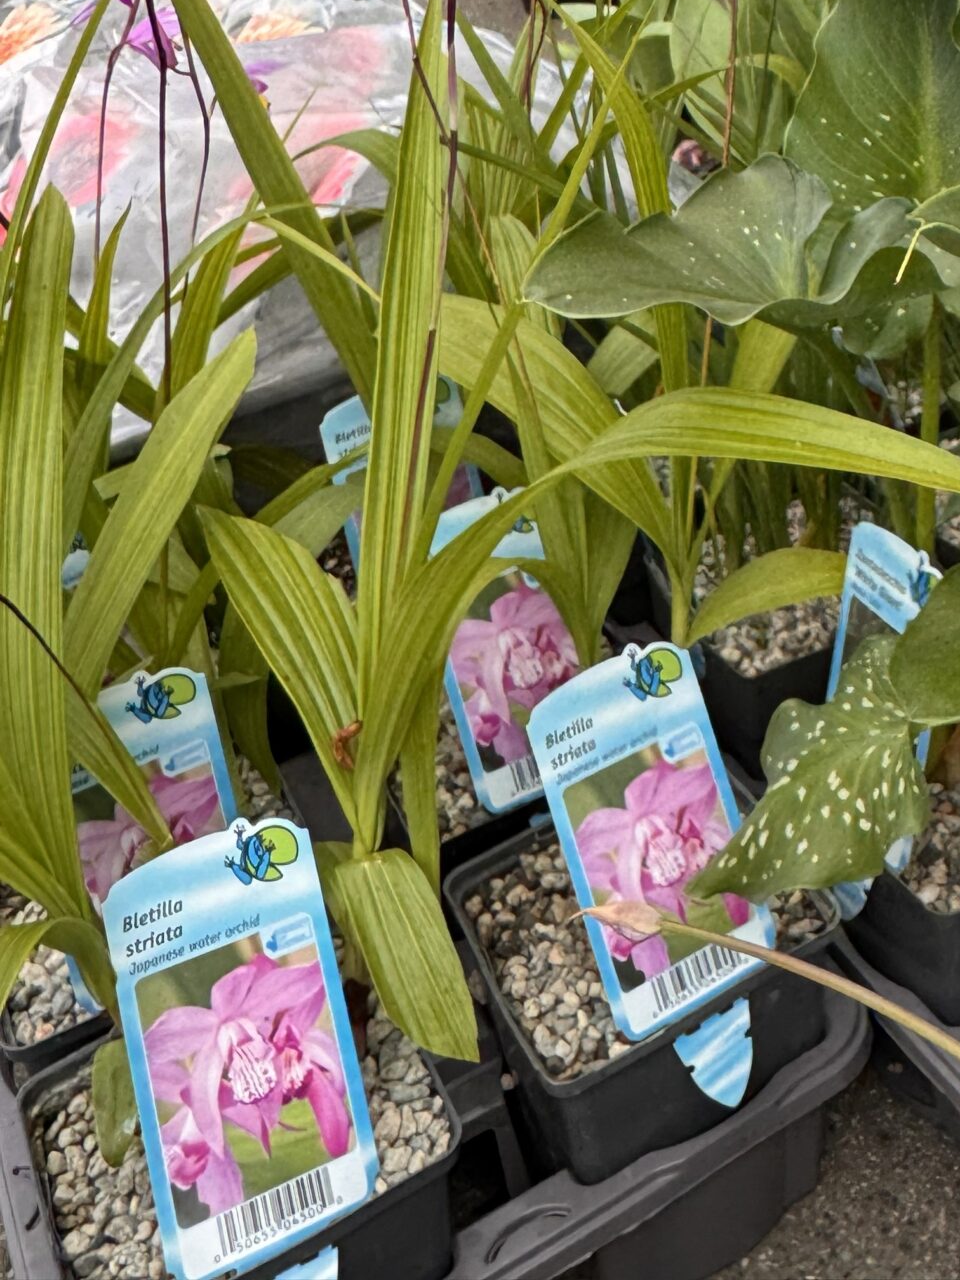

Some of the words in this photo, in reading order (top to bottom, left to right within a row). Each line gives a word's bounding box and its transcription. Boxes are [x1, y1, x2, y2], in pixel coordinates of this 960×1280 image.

[545, 717, 594, 749] Bletilla
[551, 738, 596, 770] striata
[123, 900, 183, 933] Bletilla
[126, 925, 183, 958] striata
[129, 945, 185, 976] Japanese
[189, 931, 221, 952] water
[225, 914, 260, 939] orchid
